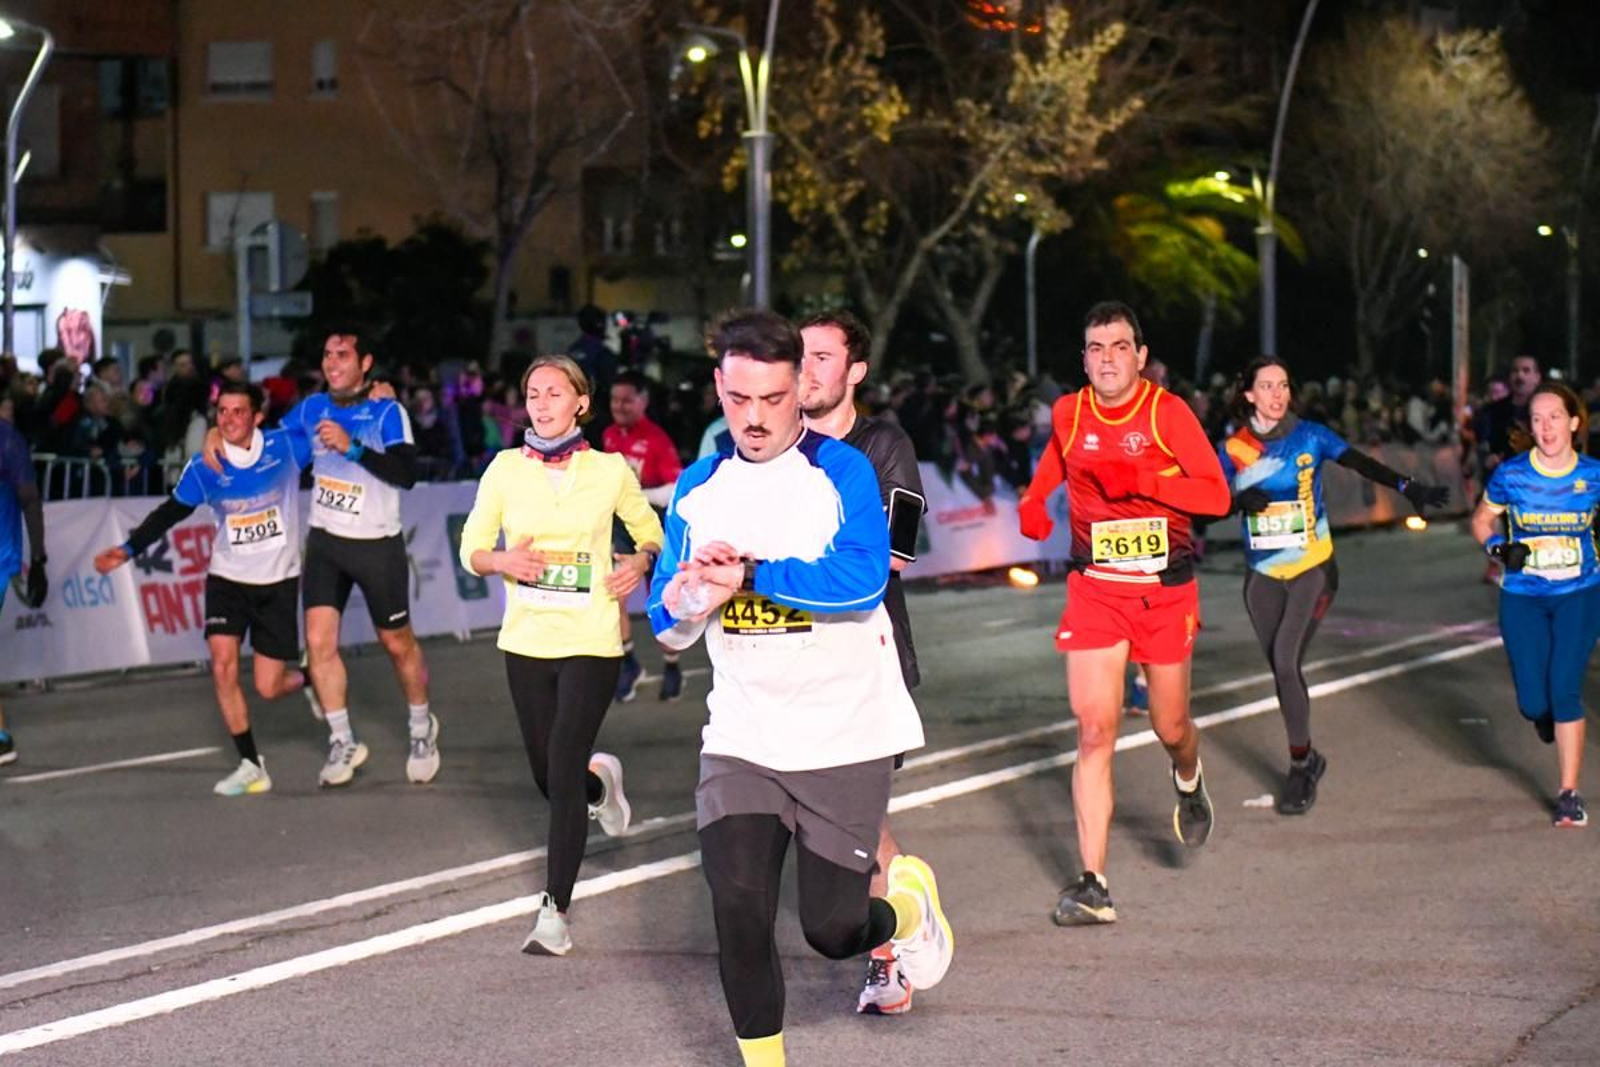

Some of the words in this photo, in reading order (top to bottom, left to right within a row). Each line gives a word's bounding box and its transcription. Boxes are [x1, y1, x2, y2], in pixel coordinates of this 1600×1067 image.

[319, 487, 358, 508] 7927
[232, 520, 278, 541] 7509
[1257, 515, 1292, 533] 857
[1100, 534, 1161, 556] 3619
[539, 564, 579, 586] 79
[62, 572, 115, 609] alsa
[723, 599, 804, 625] 4452
